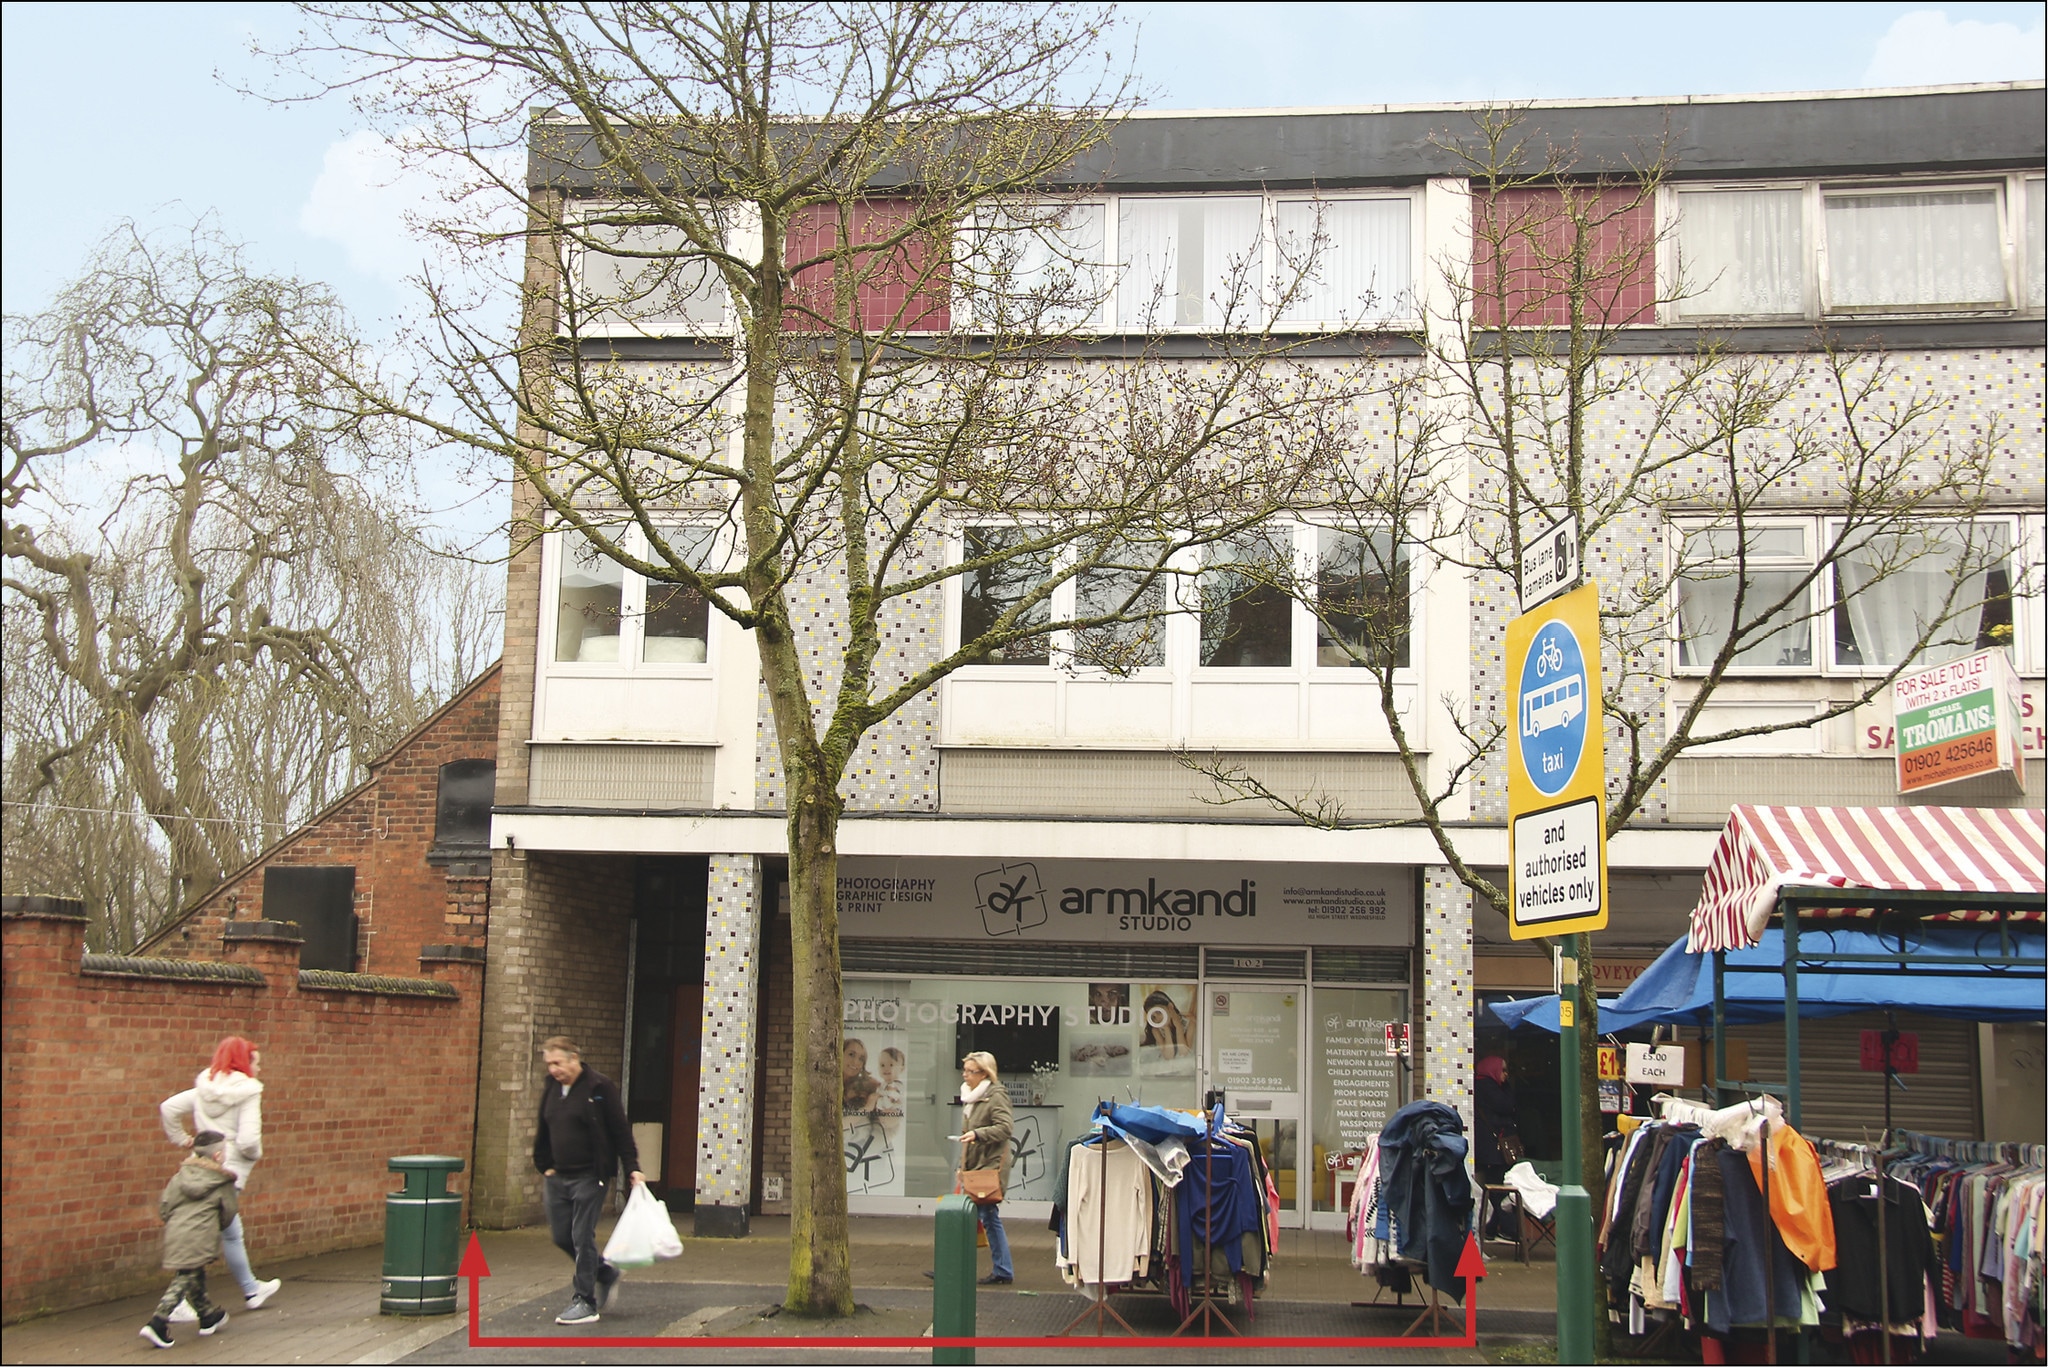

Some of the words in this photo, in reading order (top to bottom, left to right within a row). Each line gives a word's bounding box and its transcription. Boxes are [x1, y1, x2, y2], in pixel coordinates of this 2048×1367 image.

[1524, 557, 1536, 576] Bus
[1538, 547, 1553, 566] lane
[1525, 570, 1553, 598] cameras
[1896, 678, 1917, 697] FOR
[1920, 668, 1946, 690] SALE
[1950, 663, 1965, 680] TO
[1968, 655, 1988, 675] LET
[1906, 693, 1931, 710] (WITH
[1933, 690, 1938, 700] 2
[1949, 677, 1980, 697] FLATS)
[1928, 702, 1962, 718] MICHAEL
[1903, 705, 1990, 748] TROMANS
[1542, 747, 1564, 774] taxi
[1905, 750, 1941, 773] 01902
[1945, 737, 1993, 762] 425646
[1544, 819, 1565, 845] and
[1525, 845, 1586, 879] authorised
[837, 878, 935, 890] PHOTOGRAPHY
[836, 891, 886, 901] GRAPHIC
[890, 892, 932, 902] DESIGN
[1059, 877, 1256, 917] armkandi
[1283, 887, 1386, 897] info@armkandistudio.co.uk
[1520, 882, 1565, 908] vehicles
[1568, 876, 1594, 906] only
[837, 903, 843, 912] &
[848, 903, 882, 913] PRINT
[1283, 897, 1386, 906] www.armkandistudio.co.uk
[1308, 906, 1319, 914] tel:
[1322, 906, 1346, 914] 01902
[1349, 906, 1366, 915] 256
[1369, 907, 1386, 915] 992
[1119, 916, 1191, 931] STUDIO
[843, 1001, 1057, 1027] PHOTOGRAPHY
[1065, 1006, 1168, 1028] STUDIO
[1642, 1052, 1667, 1062] £5.00
[1352, 1069, 1394, 1077] PORTRAITS
[1642, 1067, 1666, 1077] EACH
[1268, 1077, 1282, 1085] 992
[1333, 1079, 1390, 1087] ENGAGEMENTS
[1334, 1089, 1356, 1097] PROM
[1340, 1120, 1382, 1128] PASSPORTS
[1344, 1141, 1366, 1149] BOUD
